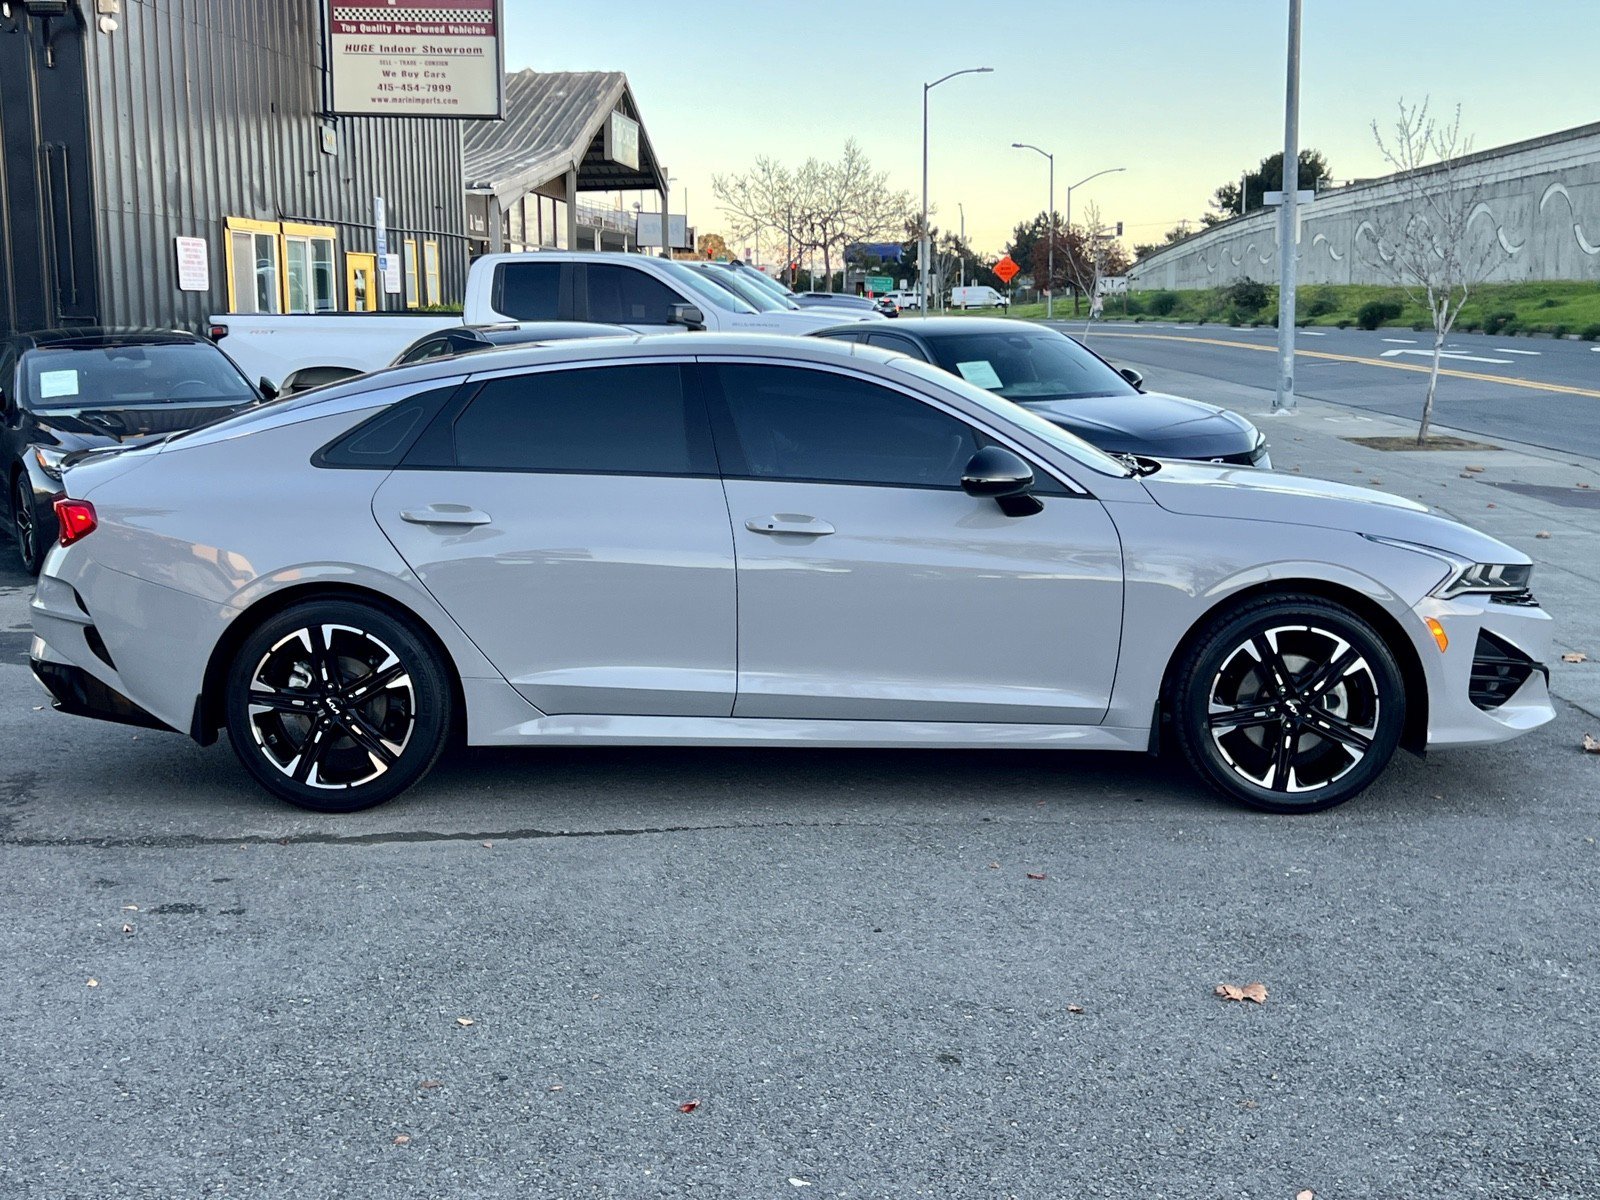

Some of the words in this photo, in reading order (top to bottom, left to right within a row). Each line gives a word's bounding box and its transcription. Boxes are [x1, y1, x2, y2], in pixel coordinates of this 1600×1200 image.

[341, 23, 357, 33] Top
[359, 23, 392, 34] Quality
[395, 24, 446, 34] Pre-Owned
[448, 25, 486, 35] Vehicles
[345, 44, 375, 53] HUGE
[379, 45, 417, 54] Indoor
[422, 45, 483, 55] Showroom
[382, 69, 397, 78] We
[401, 70, 420, 80] Buy
[423, 70, 447, 79] Cars
[377, 83, 452, 93] 415-454-7999
[371, 96, 459, 106] www.marinimports.com
